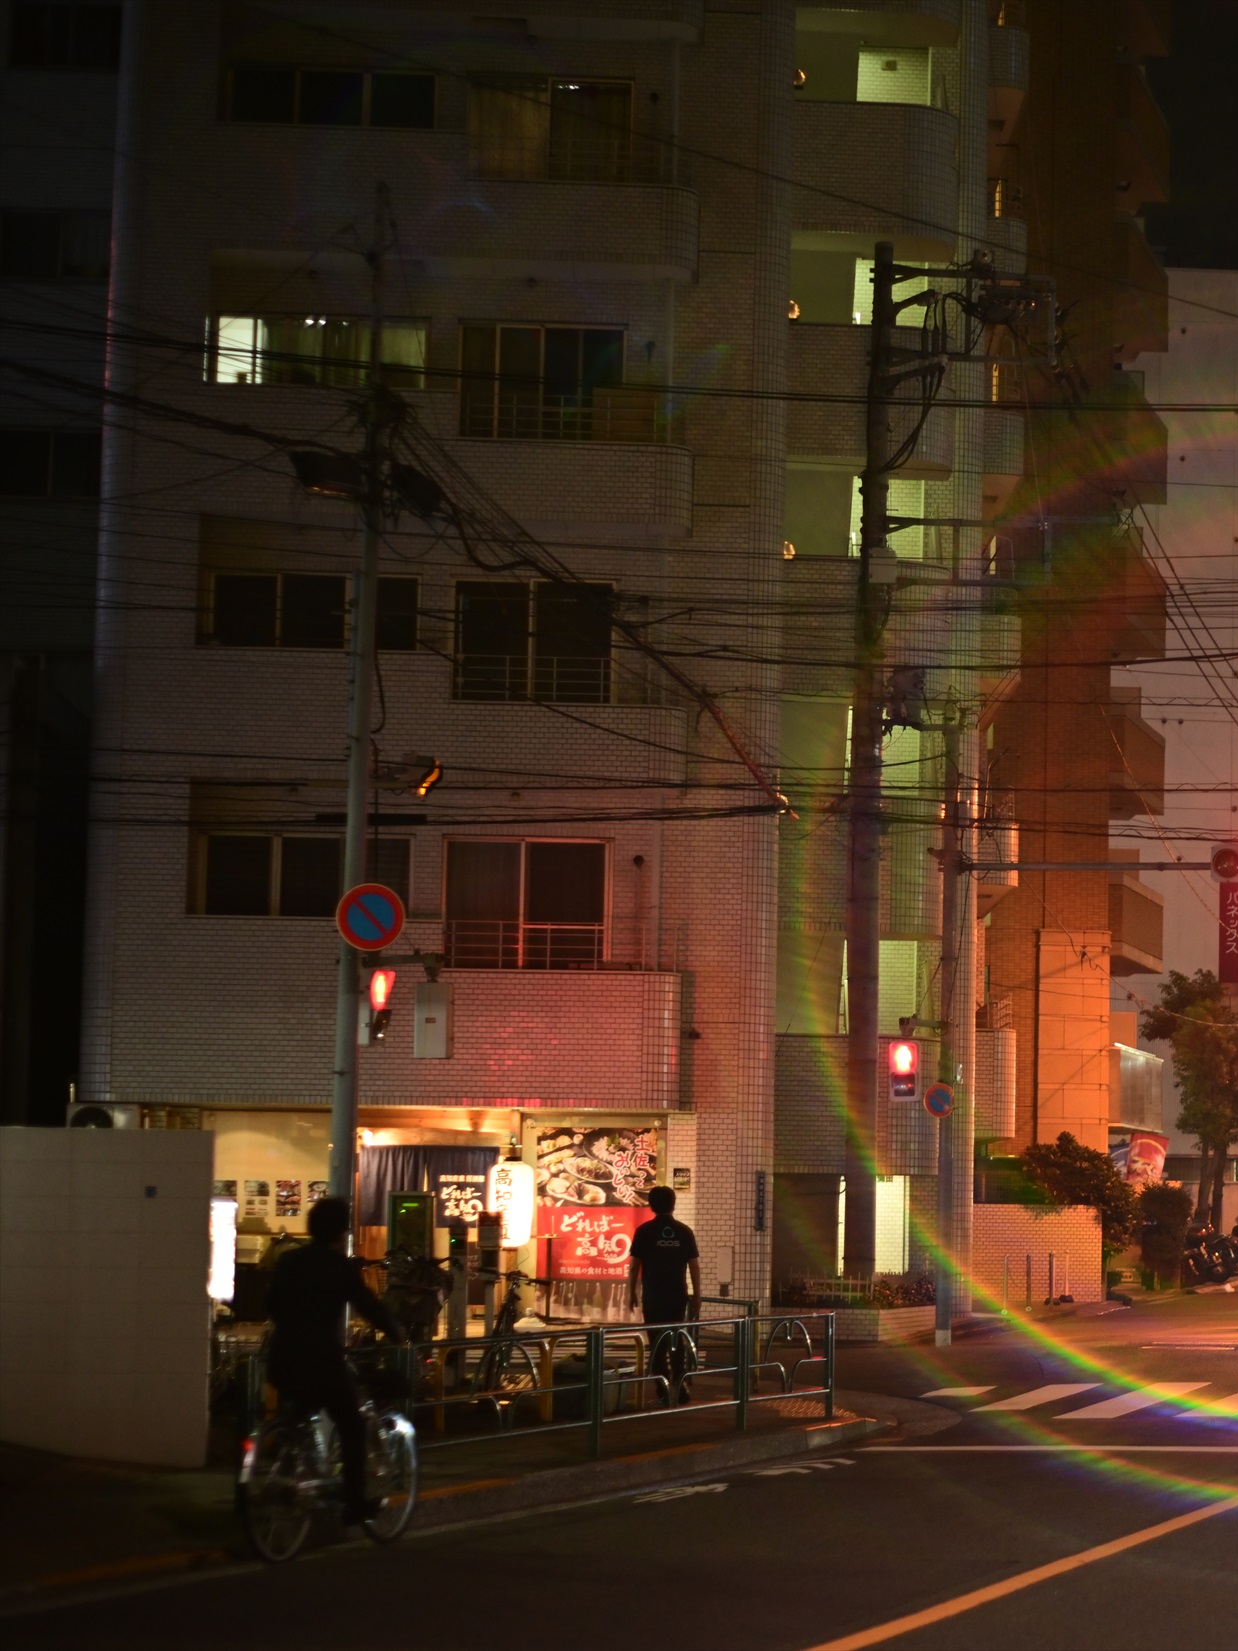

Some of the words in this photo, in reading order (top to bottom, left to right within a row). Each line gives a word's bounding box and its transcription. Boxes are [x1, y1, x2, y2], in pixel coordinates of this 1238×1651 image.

[634, 1135, 652, 1188] 土佐って
[560, 1211, 625, 1233] どればー
